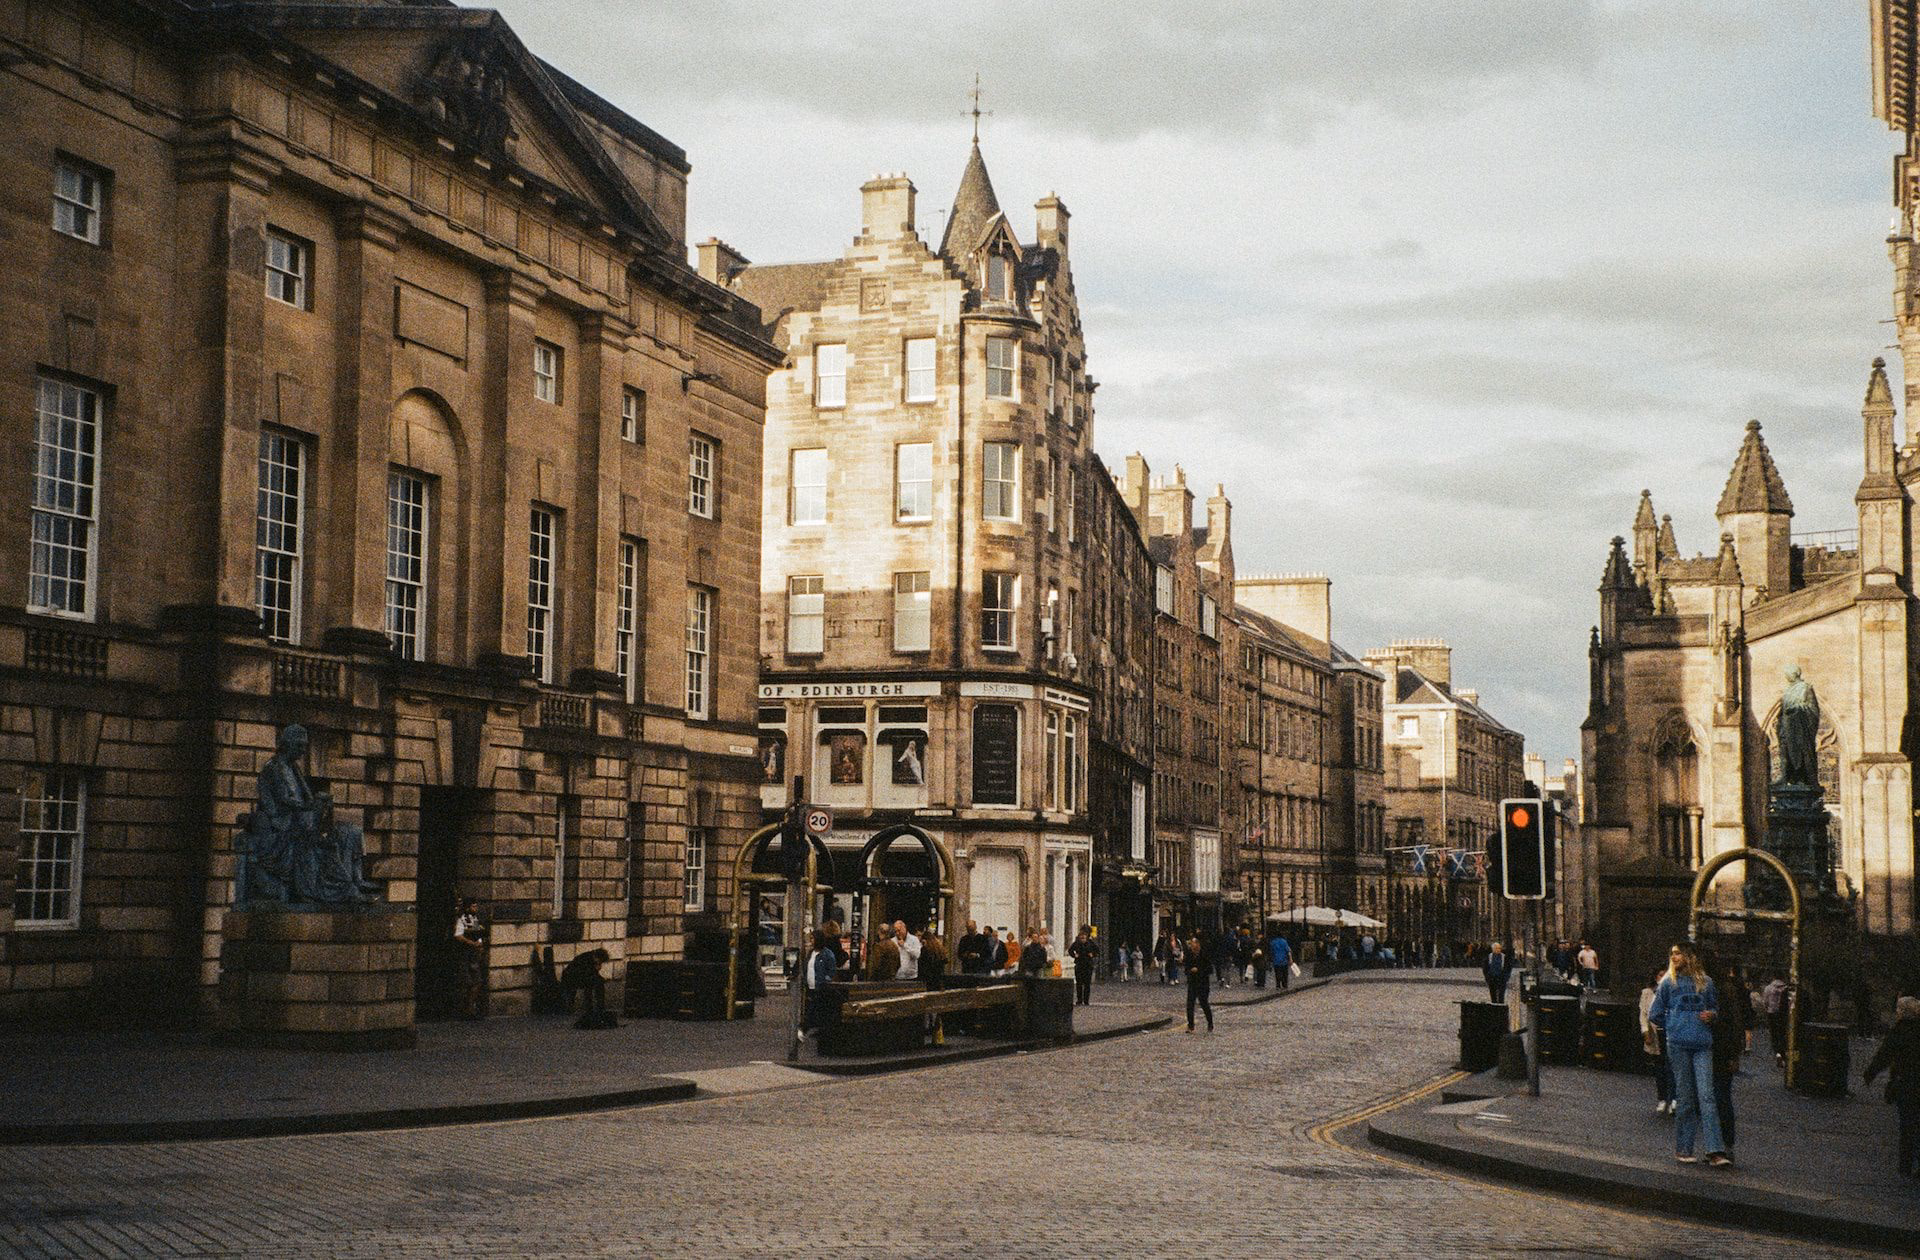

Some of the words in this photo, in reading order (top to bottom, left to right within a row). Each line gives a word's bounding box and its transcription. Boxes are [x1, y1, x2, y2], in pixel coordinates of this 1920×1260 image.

[763, 686, 783, 697] OF
[801, 685, 904, 697] EDINBURGH
[811, 815, 827, 827] 20
